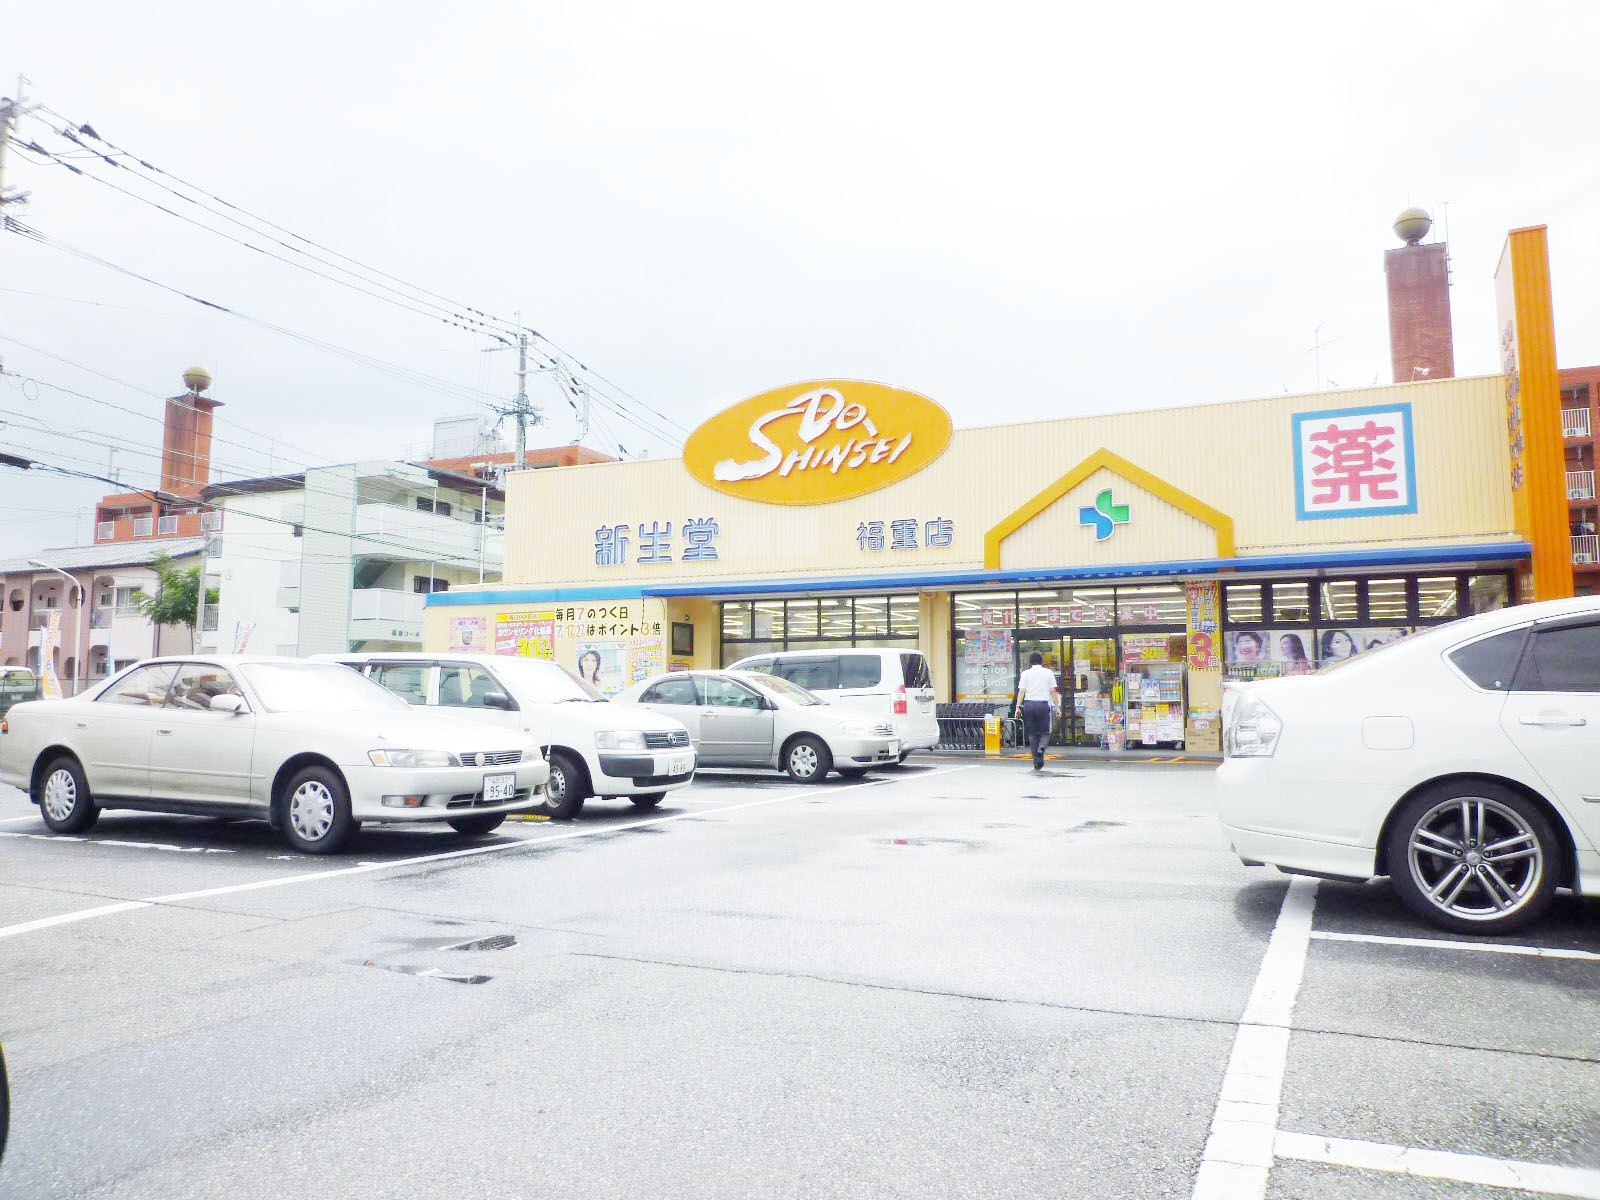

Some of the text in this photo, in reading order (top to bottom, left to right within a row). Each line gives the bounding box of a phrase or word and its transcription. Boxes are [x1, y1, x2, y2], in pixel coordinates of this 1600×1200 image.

[714, 408, 912, 481] SHINSEI
[1310, 420, 1398, 504] 薬
[594, 517, 720, 566] 新生堂
[856, 517, 953, 551] 福重店
